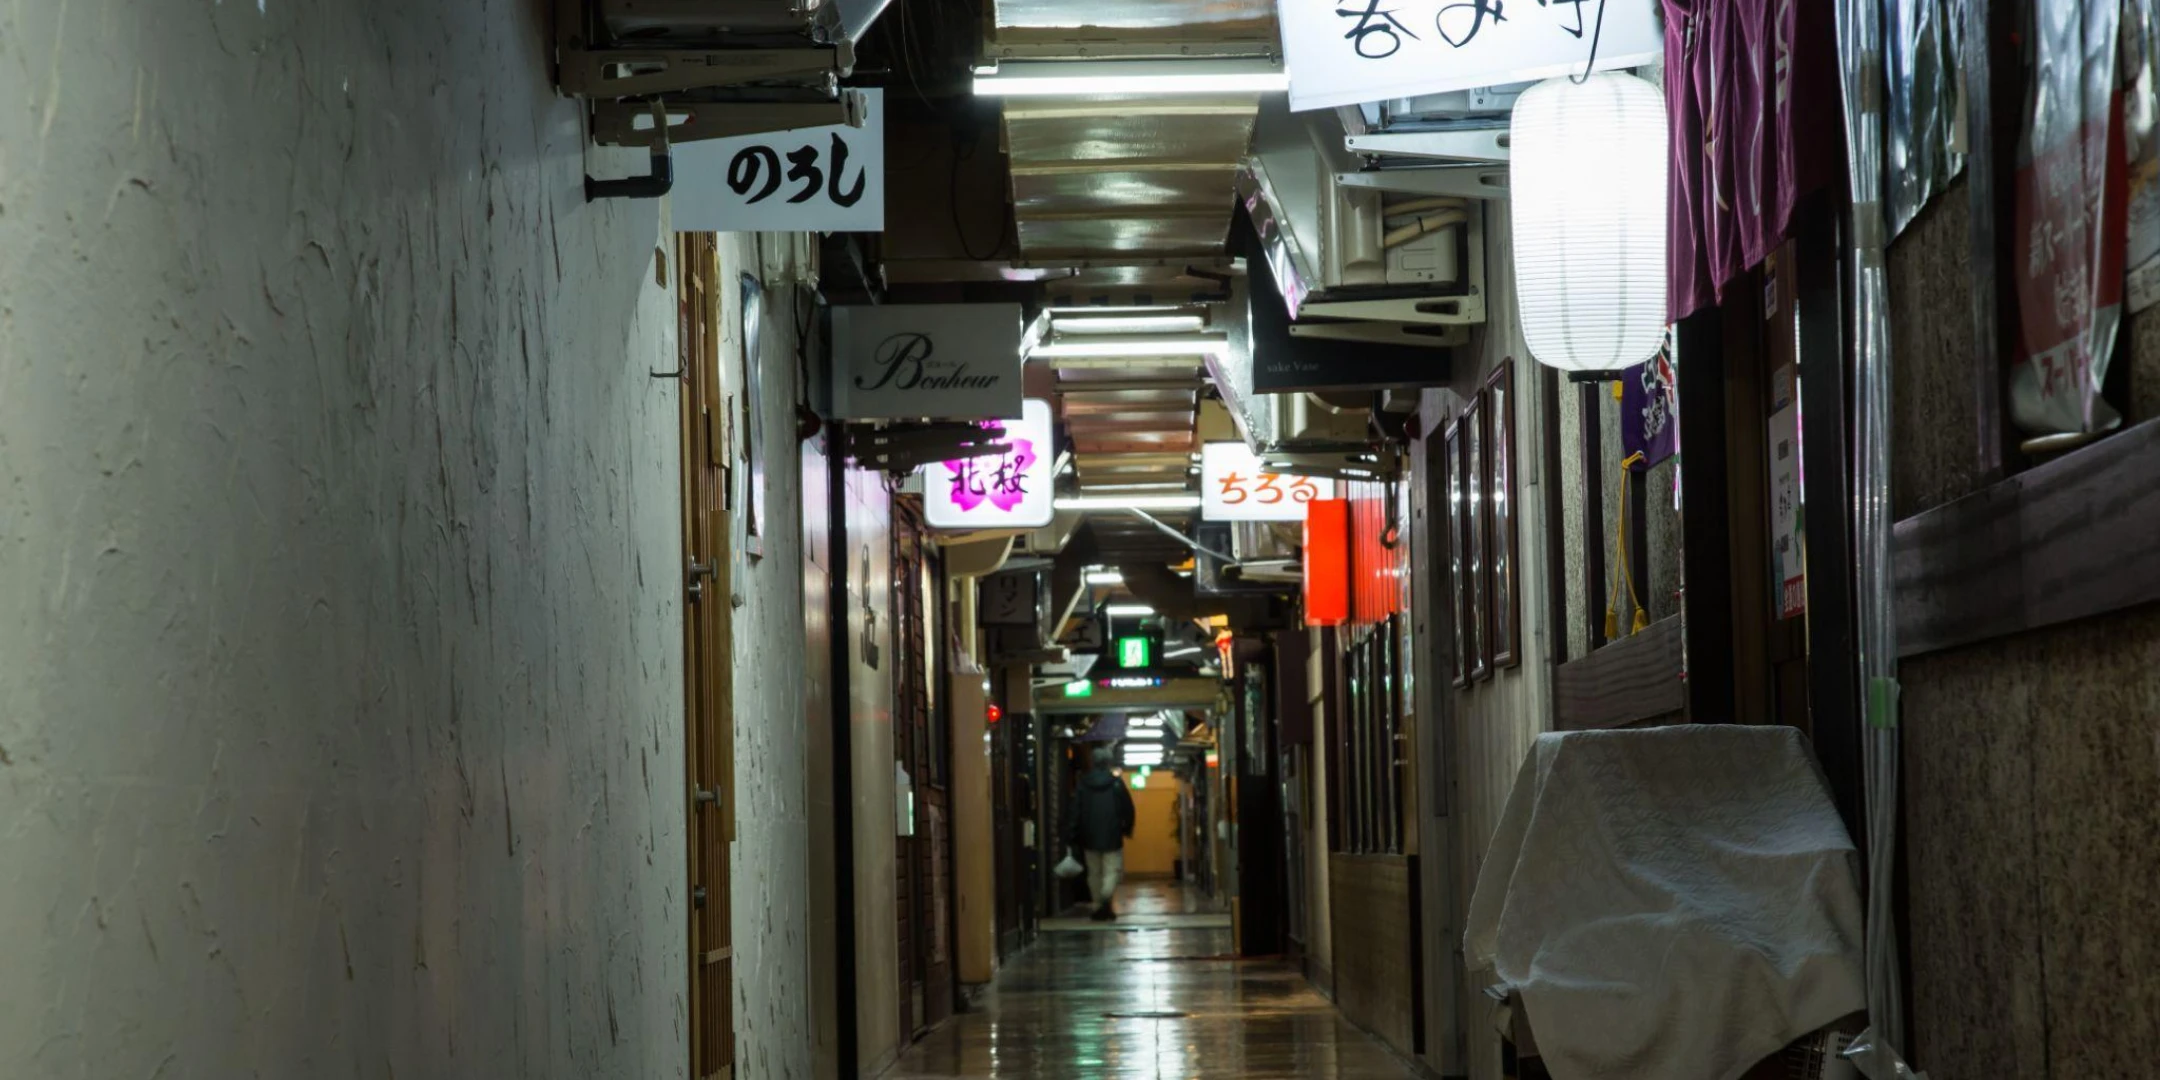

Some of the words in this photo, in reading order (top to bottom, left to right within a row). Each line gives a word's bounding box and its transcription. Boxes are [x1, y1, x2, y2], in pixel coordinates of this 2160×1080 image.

[727, 132, 866, 208] のろし
[854, 331, 1000, 392] Bonheur
[947, 452, 1030, 497] 北桜
[1218, 470, 1319, 505] ちろる
